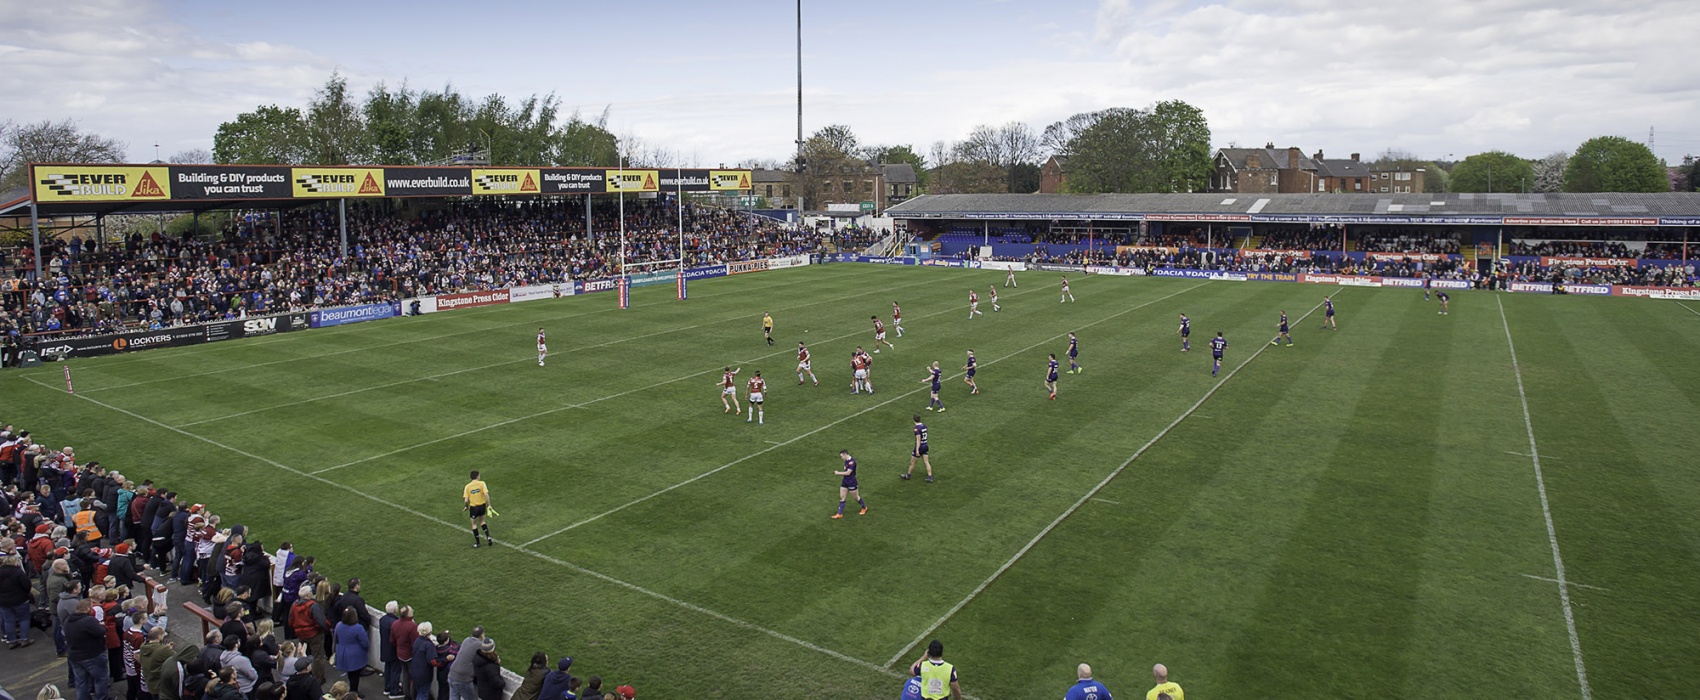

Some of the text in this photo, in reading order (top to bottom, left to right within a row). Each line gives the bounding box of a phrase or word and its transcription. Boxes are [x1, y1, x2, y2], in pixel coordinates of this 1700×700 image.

[80, 174, 126, 184] EVER
[178, 173, 285, 184] Building & DIY products
[323, 175, 355, 183] EVER
[387, 176, 470, 188] www.everbuild.co.uk
[544, 174, 566, 182] Building
[581, 174, 602, 182] products
[80, 184, 126, 195] BUILD
[135, 179, 160, 195] Sika
[204, 186, 222, 195] you
[241, 184, 263, 193] trust
[323, 183, 355, 192] BUILD
[361, 179, 379, 192] Sika
[494, 182, 518, 190] BUILD
[686, 270, 705, 278] DACIA
[1305, 275, 1336, 283] Kingstone
[1383, 279, 1468, 288] BETFRED ETFRED
[1622, 287, 1665, 296] Kingstone
[1665, 288, 1690, 296] Press
[438, 295, 473, 308] Kingstone
[473, 292, 491, 303] Press
[492, 289, 509, 301] Cider
[129, 334, 172, 346] LOCKYERS
